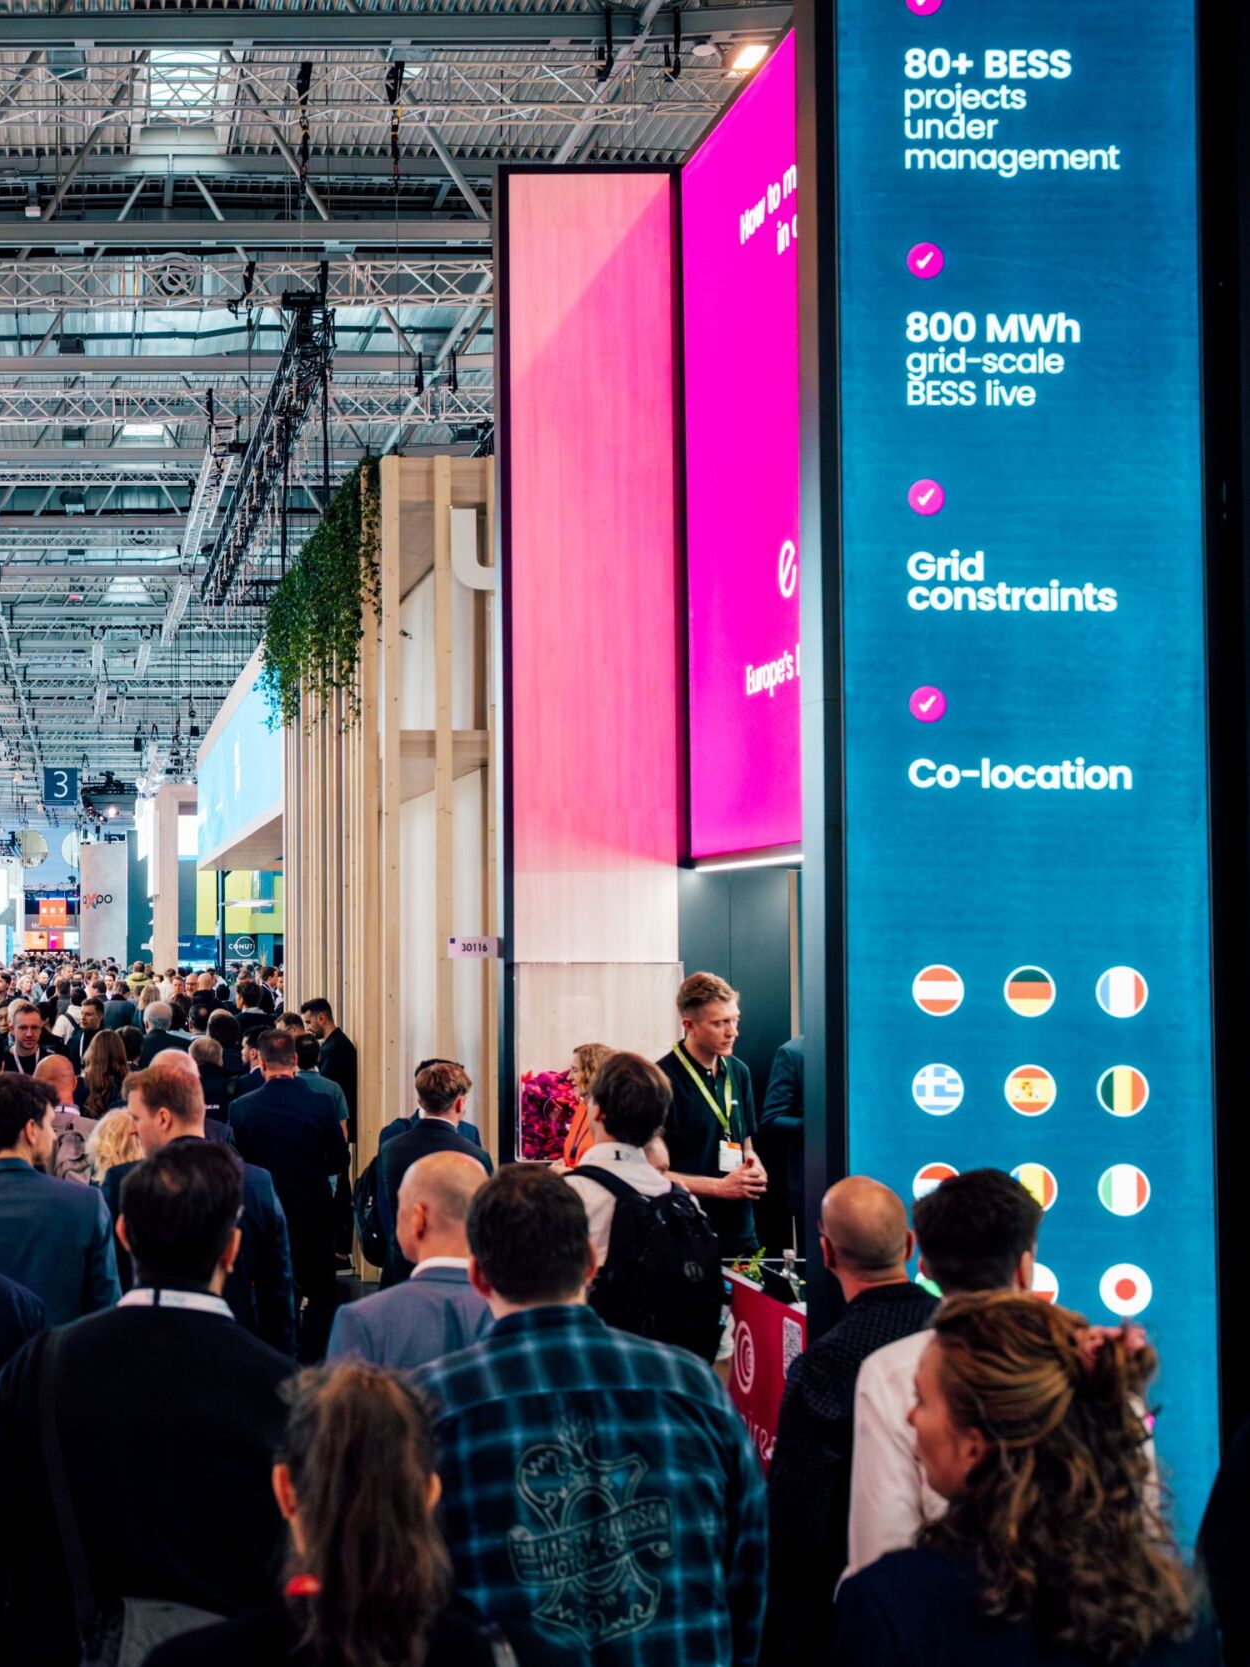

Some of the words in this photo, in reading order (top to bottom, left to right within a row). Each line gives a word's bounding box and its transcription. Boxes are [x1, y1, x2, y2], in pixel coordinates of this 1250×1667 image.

[904, 47, 974, 79] 80+
[984, 49, 1072, 79] BESS
[904, 83, 1027, 117] projects
[904, 114, 999, 139] under
[904, 145, 1120, 177] management
[739, 195, 766, 245] How
[766, 181, 781, 214] to
[776, 219, 790, 255] in
[906, 311, 977, 343] 800
[986, 312, 1081, 343] MWh
[906, 346, 1065, 381] grid-scale
[907, 380, 977, 406] BESS
[986, 379, 1036, 407] live
[907, 549, 985, 583] Grid
[907, 578, 1118, 612] constraints
[746, 650, 794, 697] Europe's
[53, 770, 69, 798] 3
[908, 757, 1133, 790] Co-location
[461, 943, 488, 952] 30116
